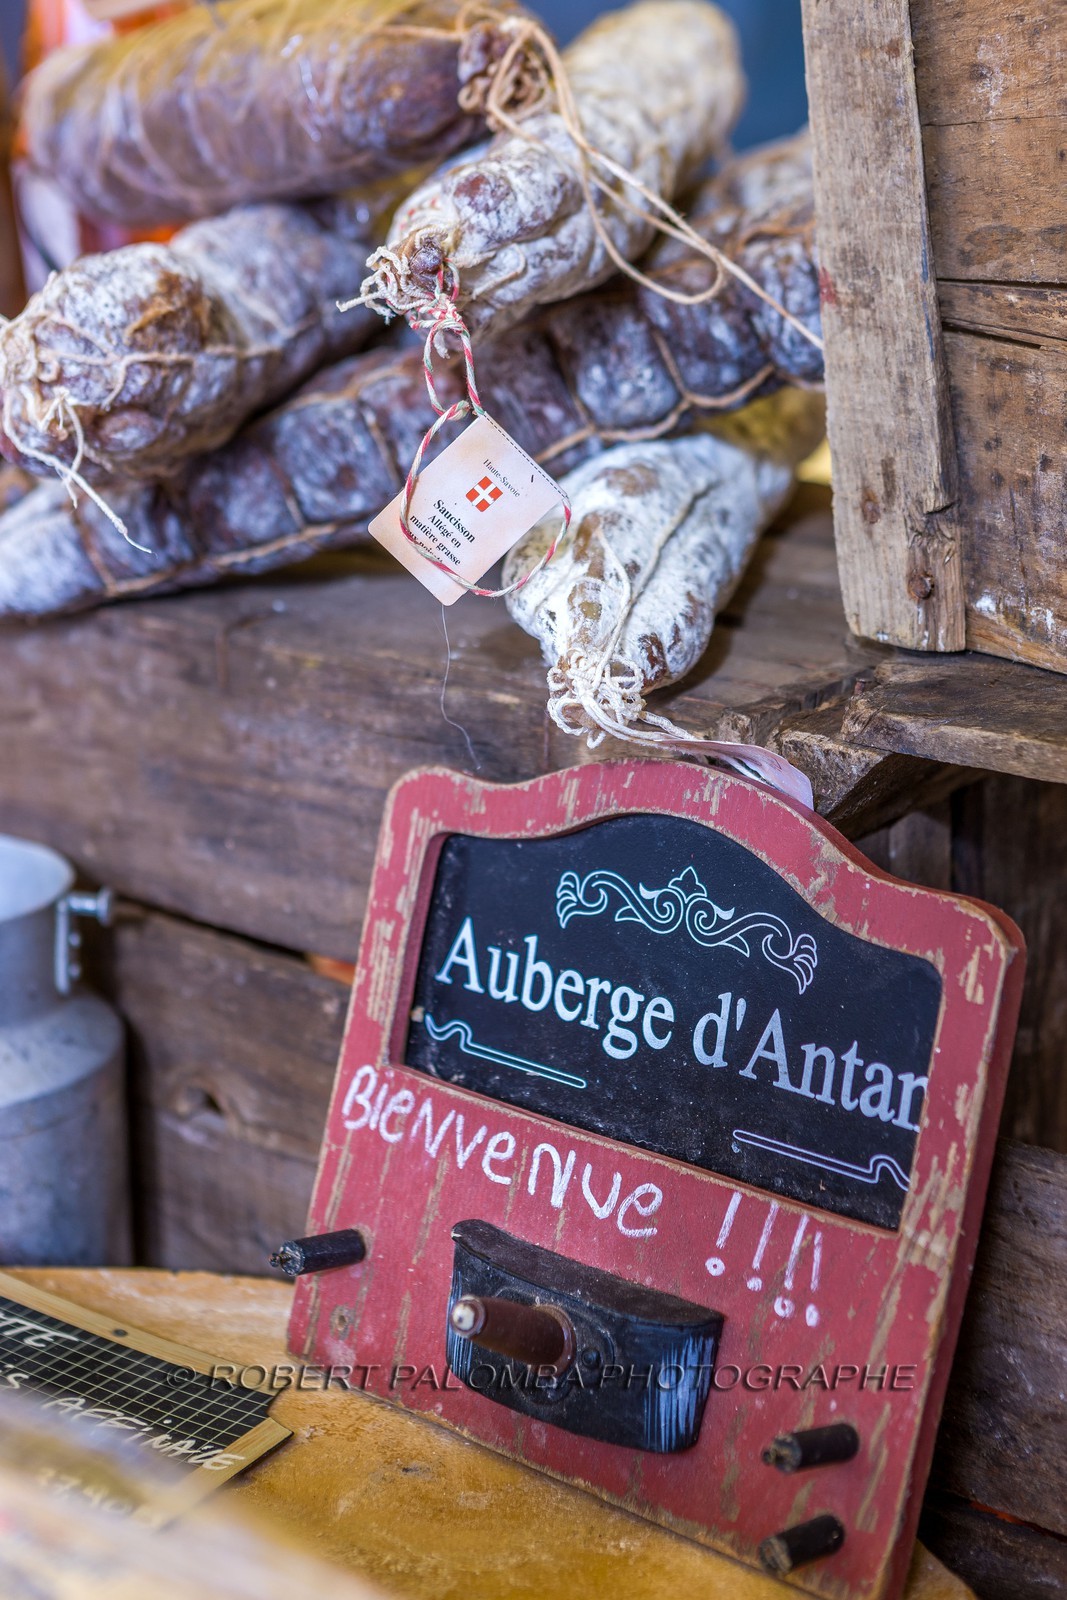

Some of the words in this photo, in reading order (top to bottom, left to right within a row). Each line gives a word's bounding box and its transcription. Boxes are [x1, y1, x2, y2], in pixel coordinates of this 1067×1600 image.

[482, 458, 521, 498] Haute-Savoie
[409, 515, 439, 544] matière
[435, 542, 461, 566] grasse
[427, 514, 453, 540] Allégé
[450, 536, 462, 549] en
[433, 499, 476, 544] Saucisson
[434, 916, 675, 1060] Auberge
